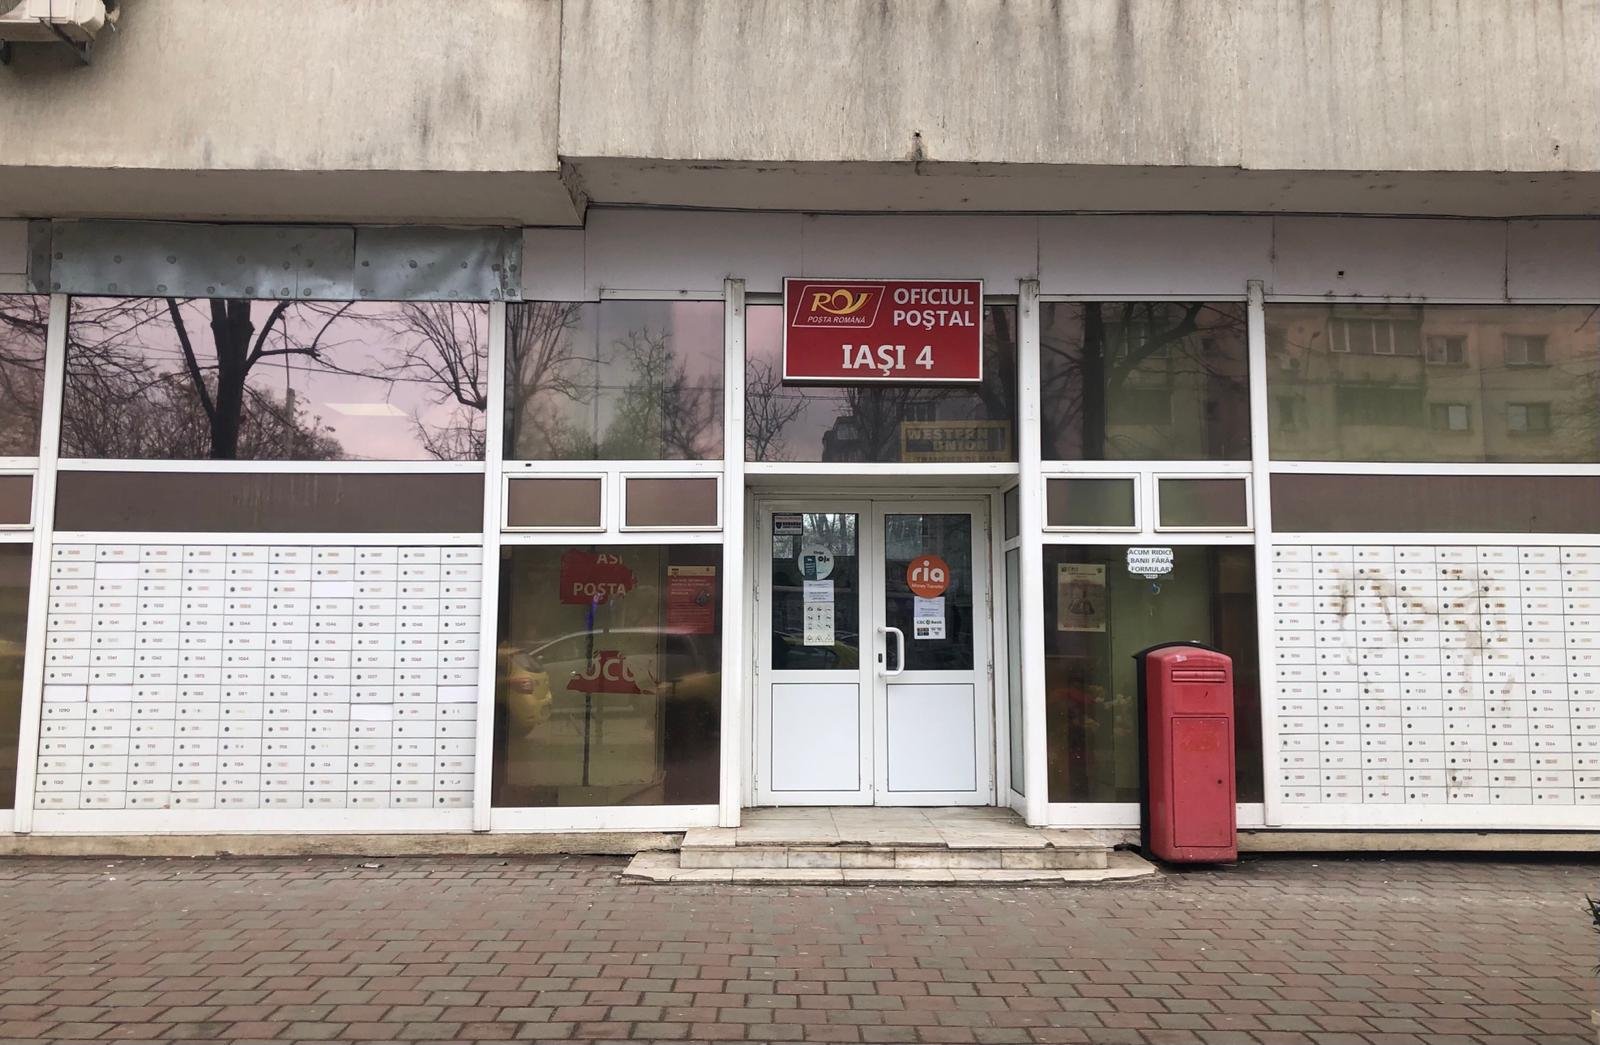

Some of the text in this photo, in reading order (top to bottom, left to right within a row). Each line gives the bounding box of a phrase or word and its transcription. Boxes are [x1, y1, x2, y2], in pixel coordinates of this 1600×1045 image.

[893, 288, 974, 305] OFICIUL
[915, 345, 934, 370] 4
[907, 429, 990, 441] WESTERN
[933, 440, 990, 451] UNION
[911, 559, 945, 583] ria
